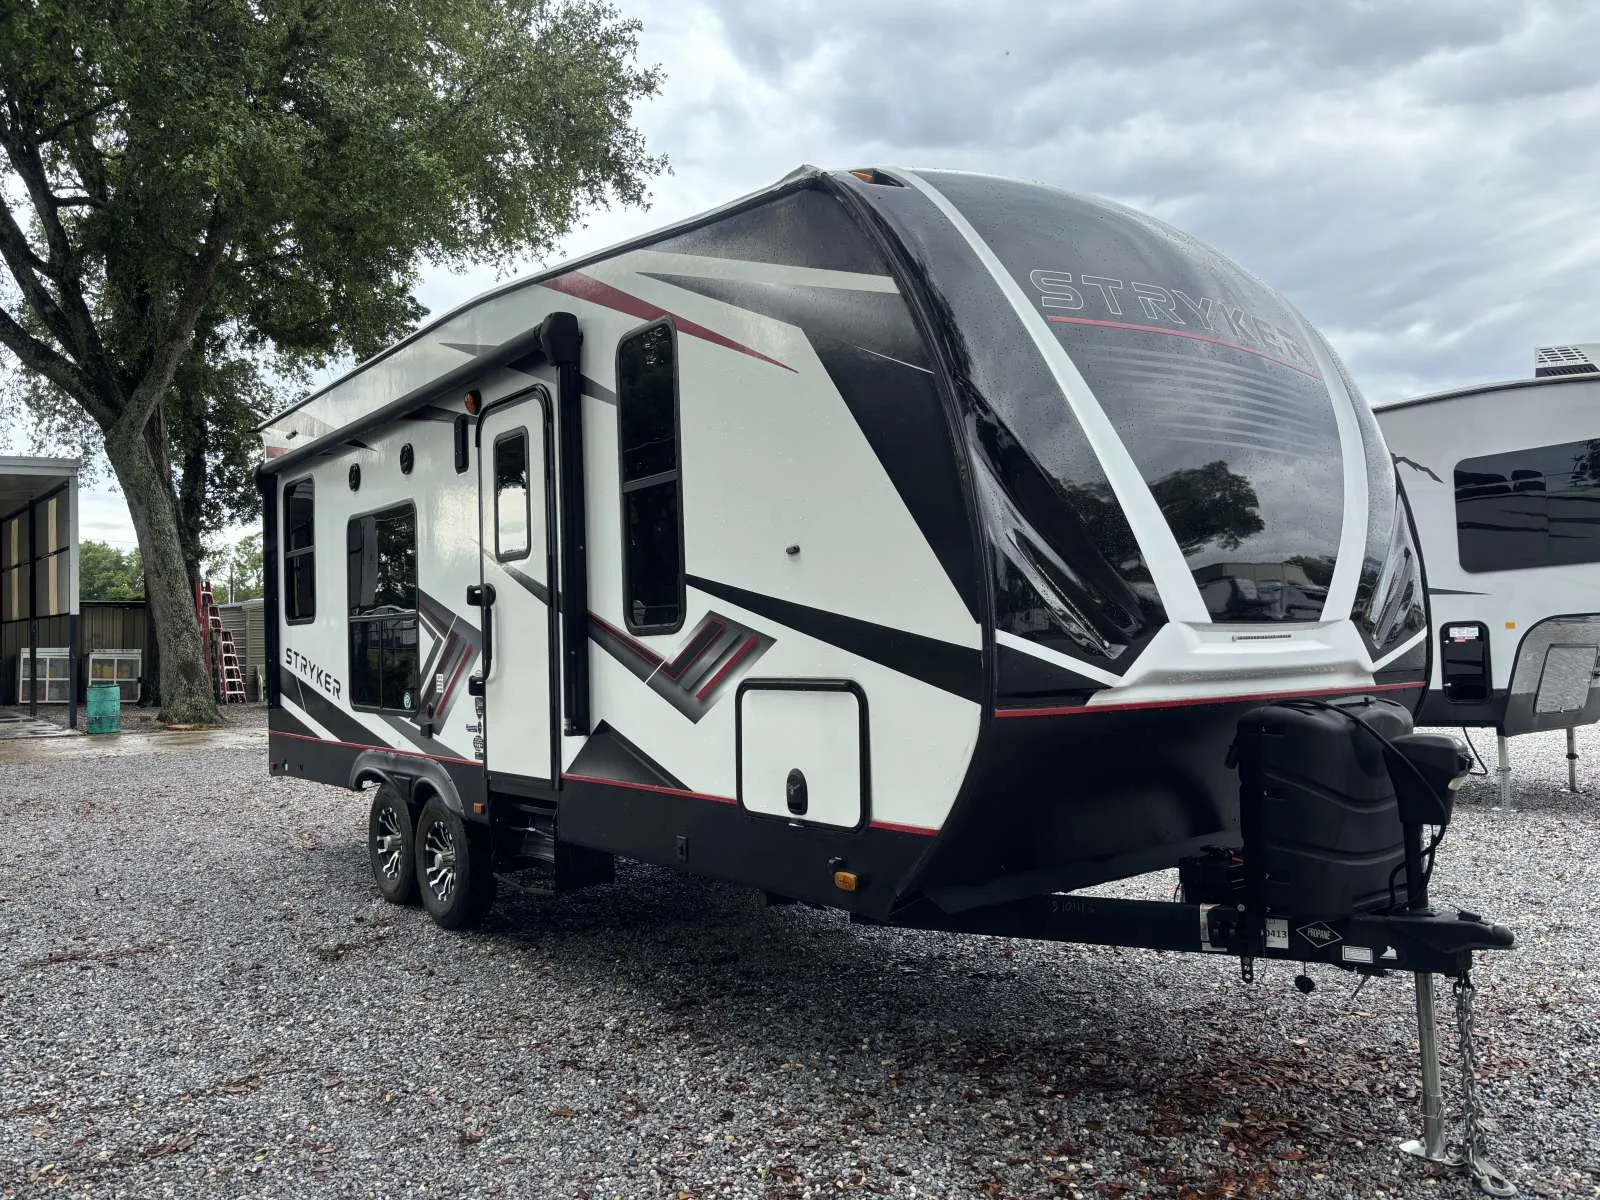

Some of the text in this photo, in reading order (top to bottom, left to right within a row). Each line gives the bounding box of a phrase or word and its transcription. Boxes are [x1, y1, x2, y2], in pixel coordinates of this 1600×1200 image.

[1029, 269, 1316, 371] STRYKER
[285, 647, 342, 700] STRYKER
[1307, 927, 1331, 940] PROPANE
